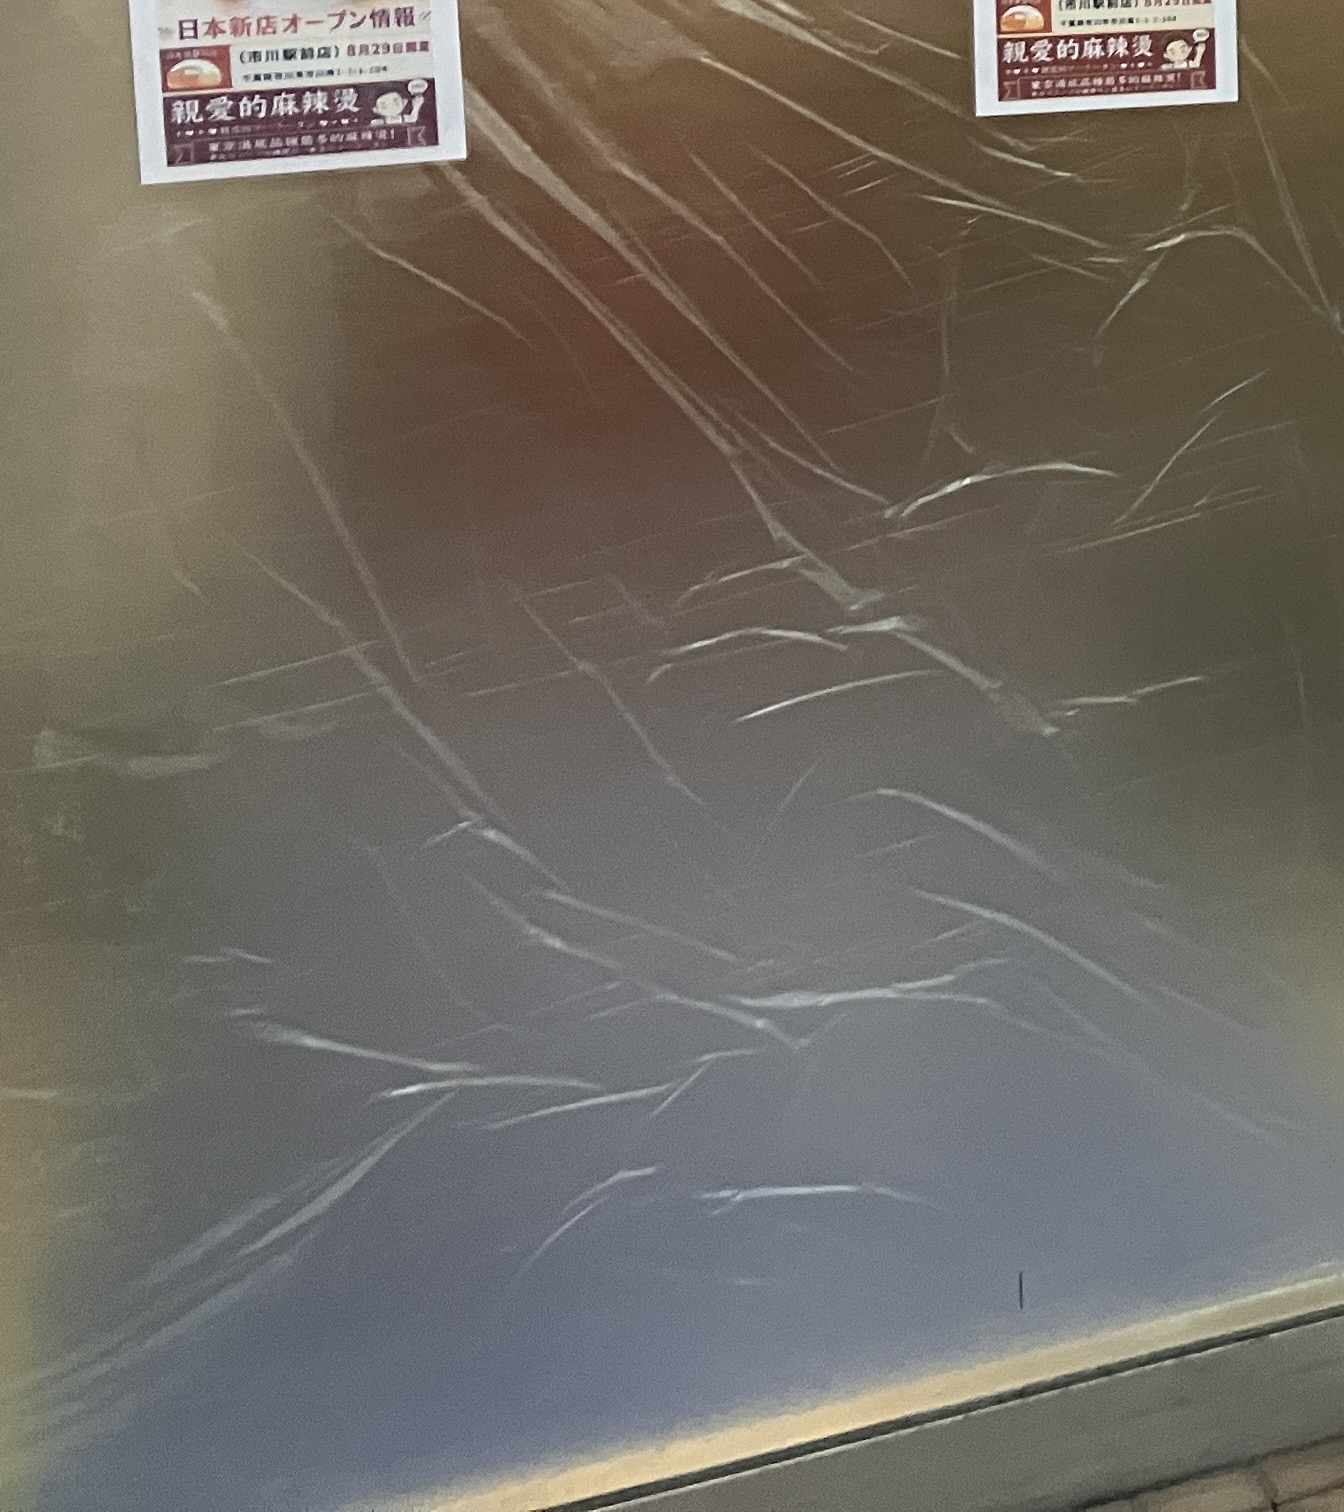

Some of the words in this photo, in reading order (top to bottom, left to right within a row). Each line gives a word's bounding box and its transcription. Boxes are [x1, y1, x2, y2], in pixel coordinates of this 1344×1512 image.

[178, 6, 416, 41] 日本新店オープン情報
